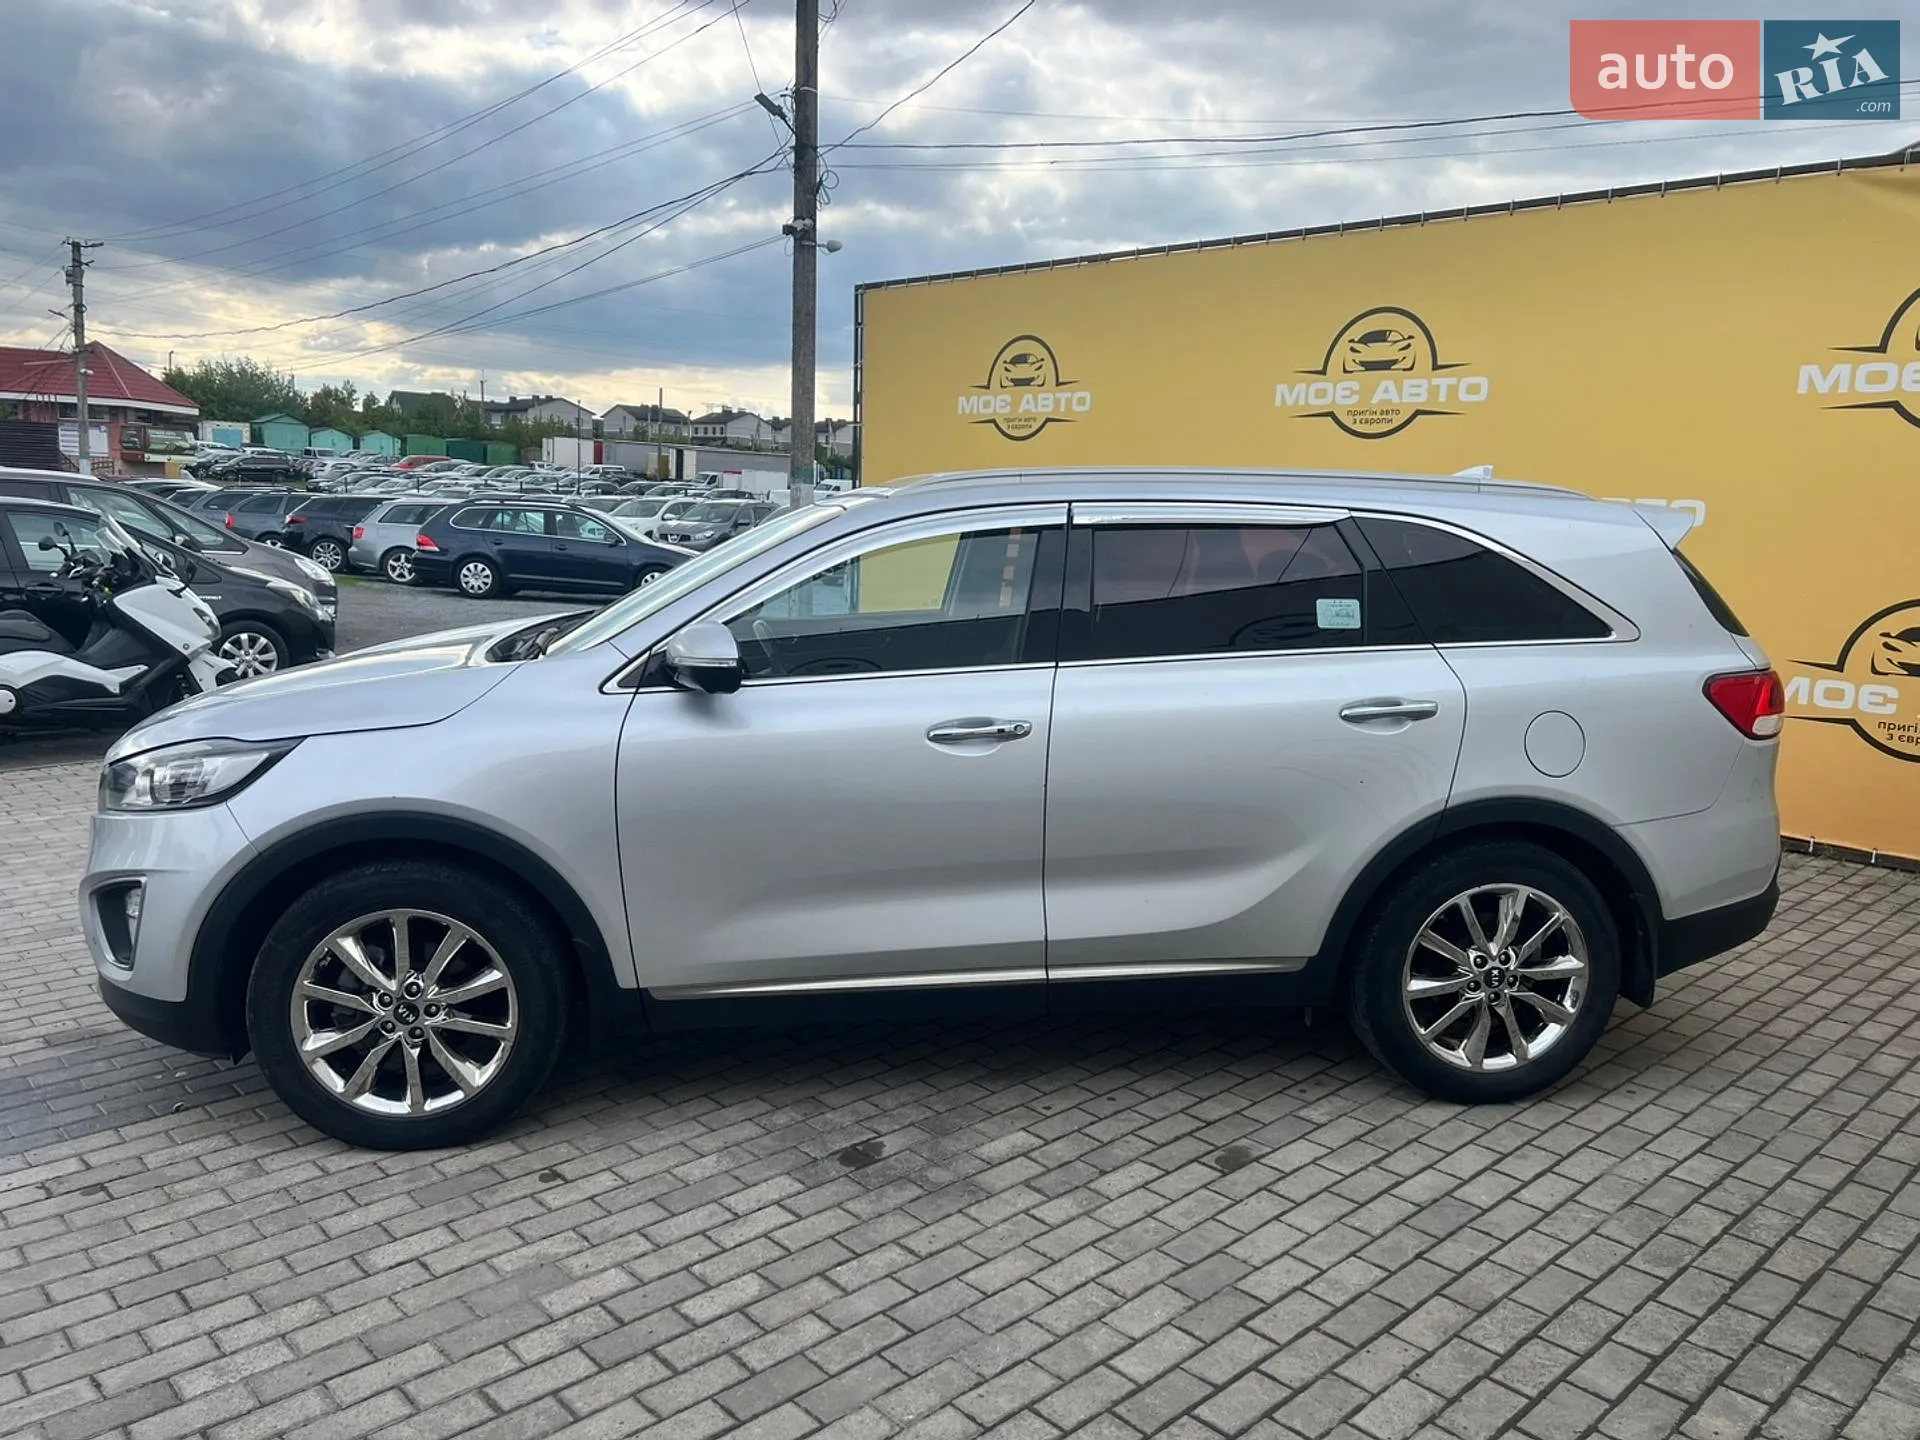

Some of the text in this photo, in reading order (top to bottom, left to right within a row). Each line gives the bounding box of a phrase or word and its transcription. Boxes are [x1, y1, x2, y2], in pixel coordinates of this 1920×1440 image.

[1274, 376, 1489, 407] МОЄ АВТО
[957, 391, 1091, 414] МОЄ АВТО
[1379, 408, 1401, 416] авто
[1877, 721, 1920, 733] пригі
[1886, 733, 1894, 741] з
